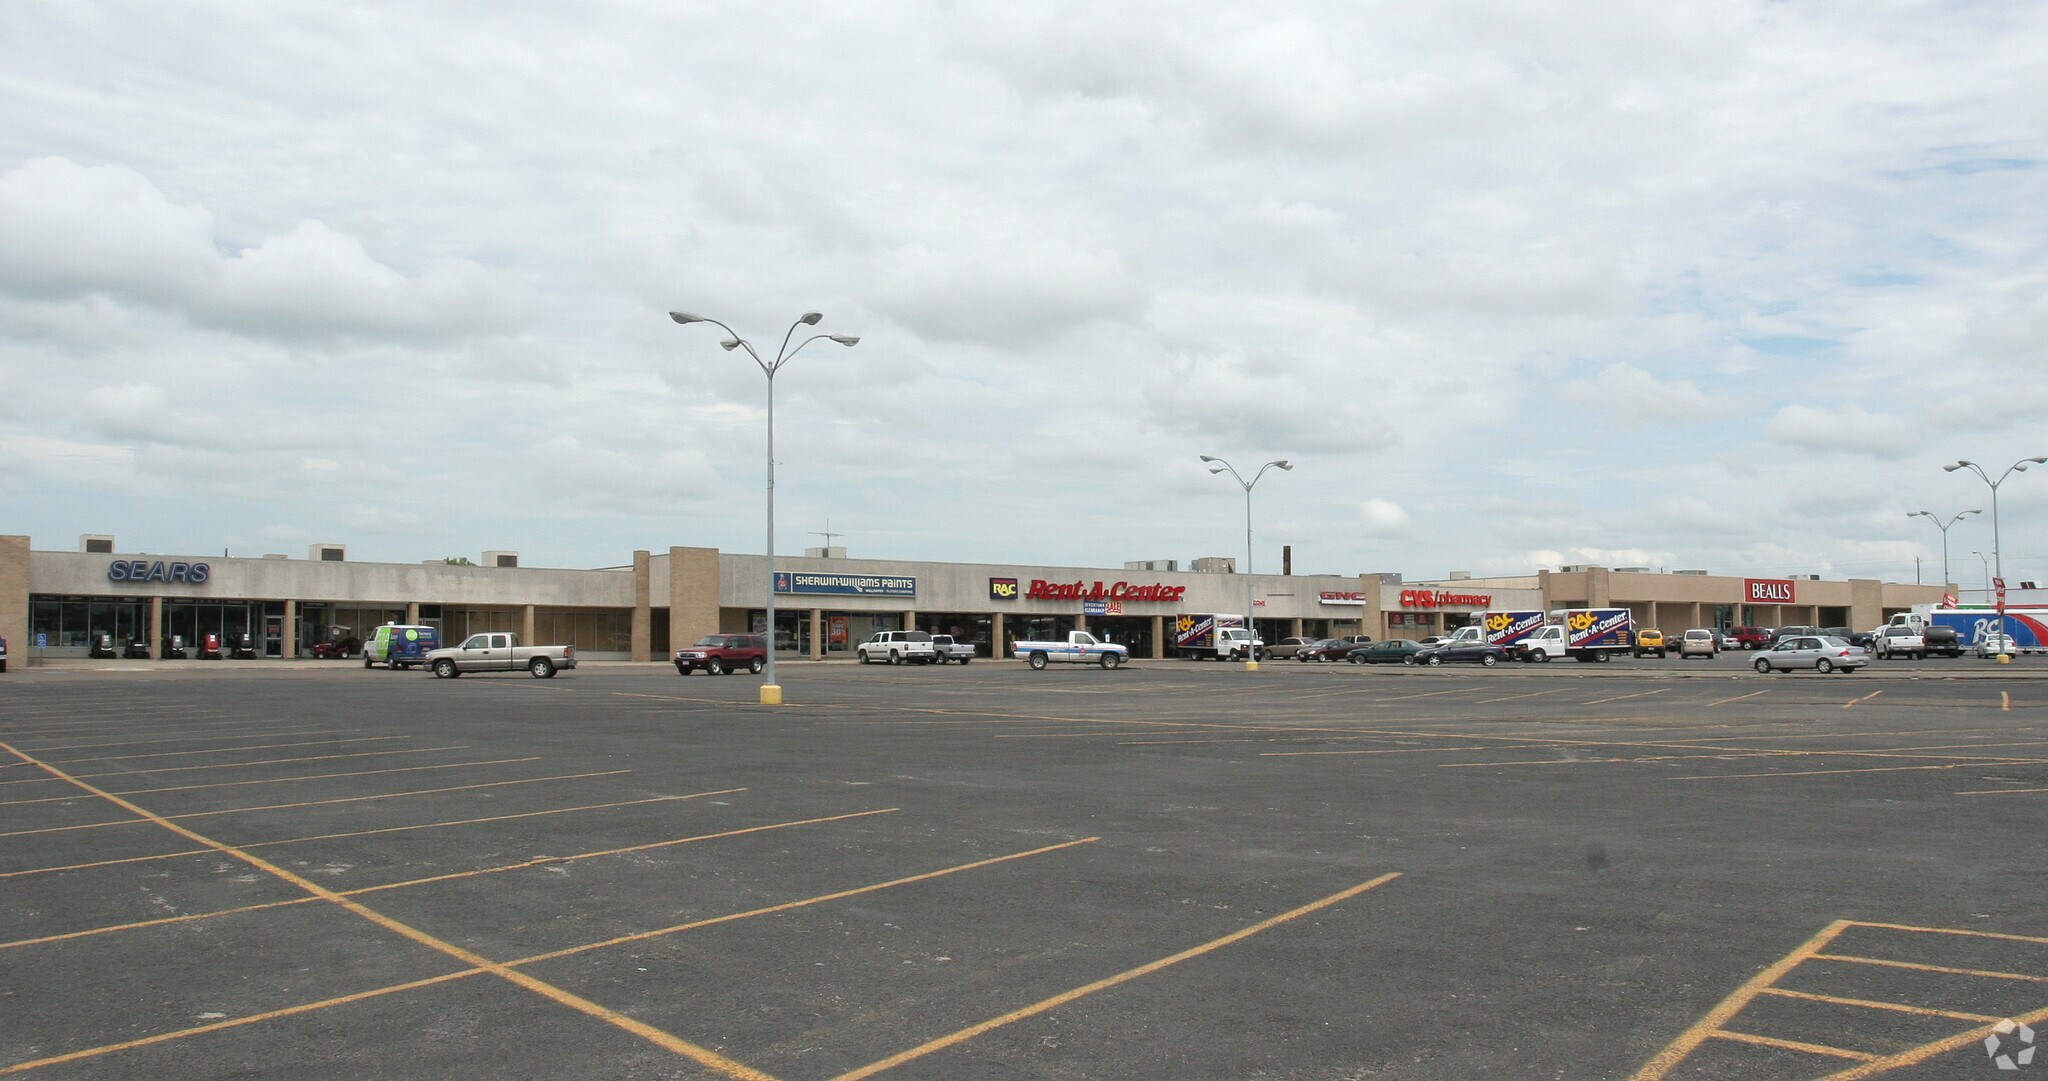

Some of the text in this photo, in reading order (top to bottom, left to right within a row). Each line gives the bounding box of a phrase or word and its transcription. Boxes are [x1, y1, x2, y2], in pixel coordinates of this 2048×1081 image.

[108, 560, 210, 583] SEARS
[993, 583, 1016, 597] RAC
[1320, 591, 1366, 600] GNC
[1401, 589, 1492, 608] CVS/pharmacy
[1752, 583, 1790, 600] BEALLS
[1178, 615, 1195, 632] RAC
[1485, 612, 1514, 632] RAC
[1568, 611, 1598, 631] RAC
